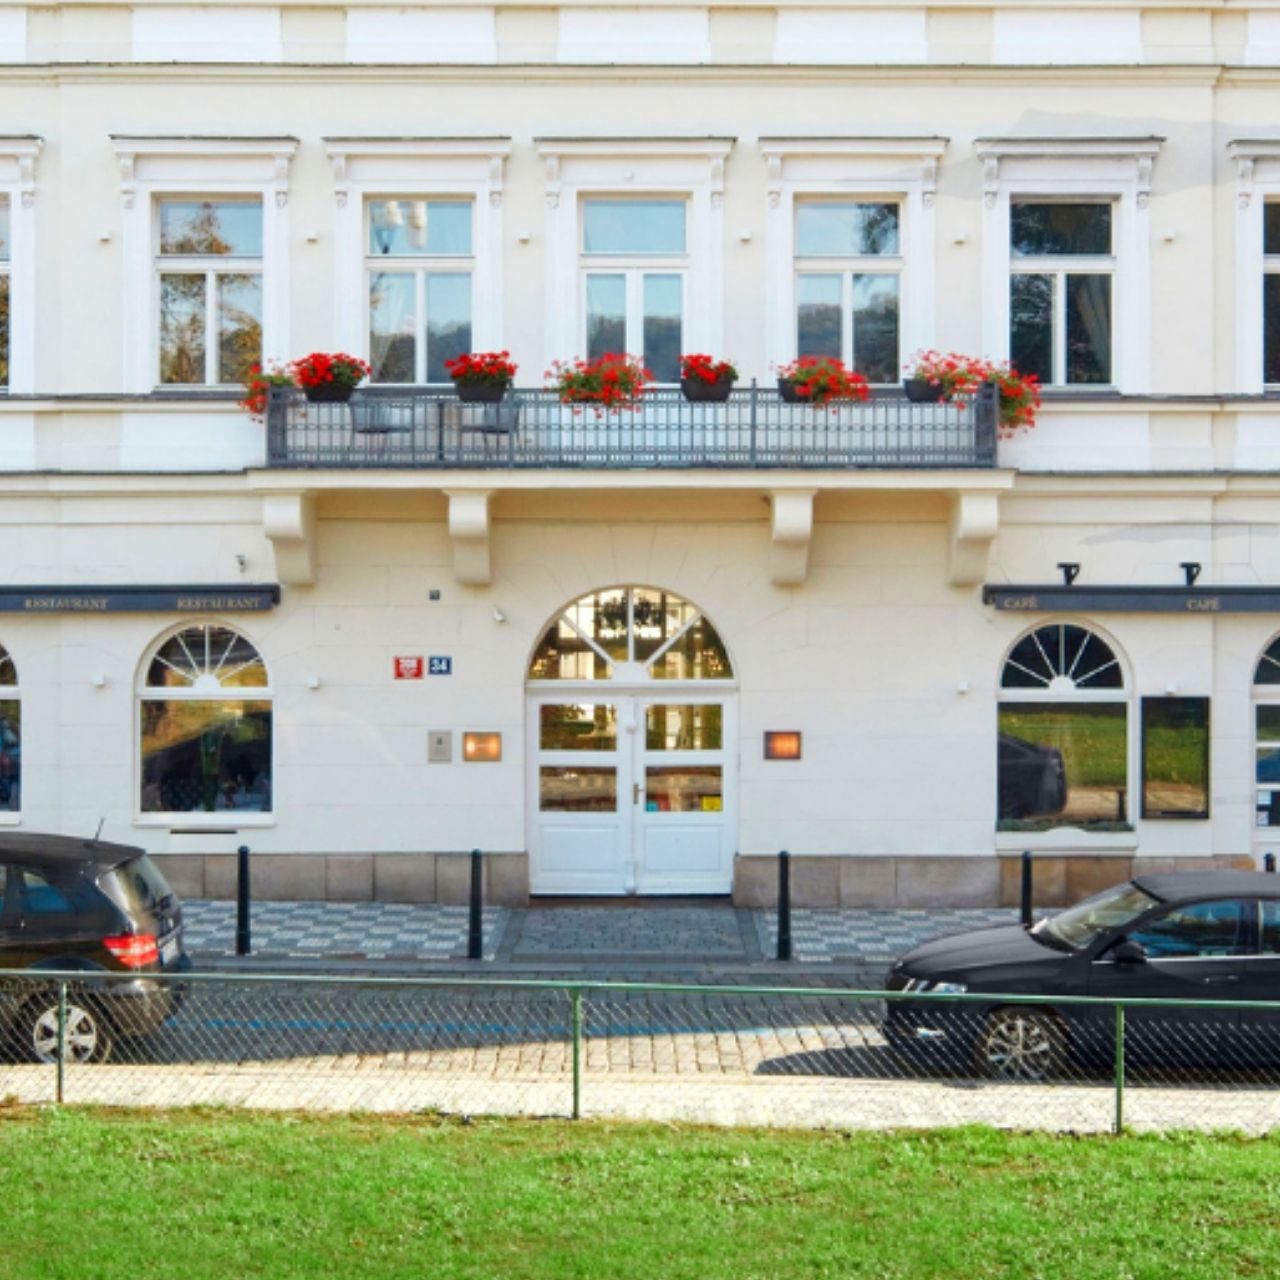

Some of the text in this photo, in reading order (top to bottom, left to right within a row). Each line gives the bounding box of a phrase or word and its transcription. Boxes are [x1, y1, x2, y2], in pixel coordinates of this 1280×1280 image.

[24, 597, 109, 610] RESTAURANT
[177, 597, 262, 610] RESTAURANT
[431, 658, 448, 671] 34
